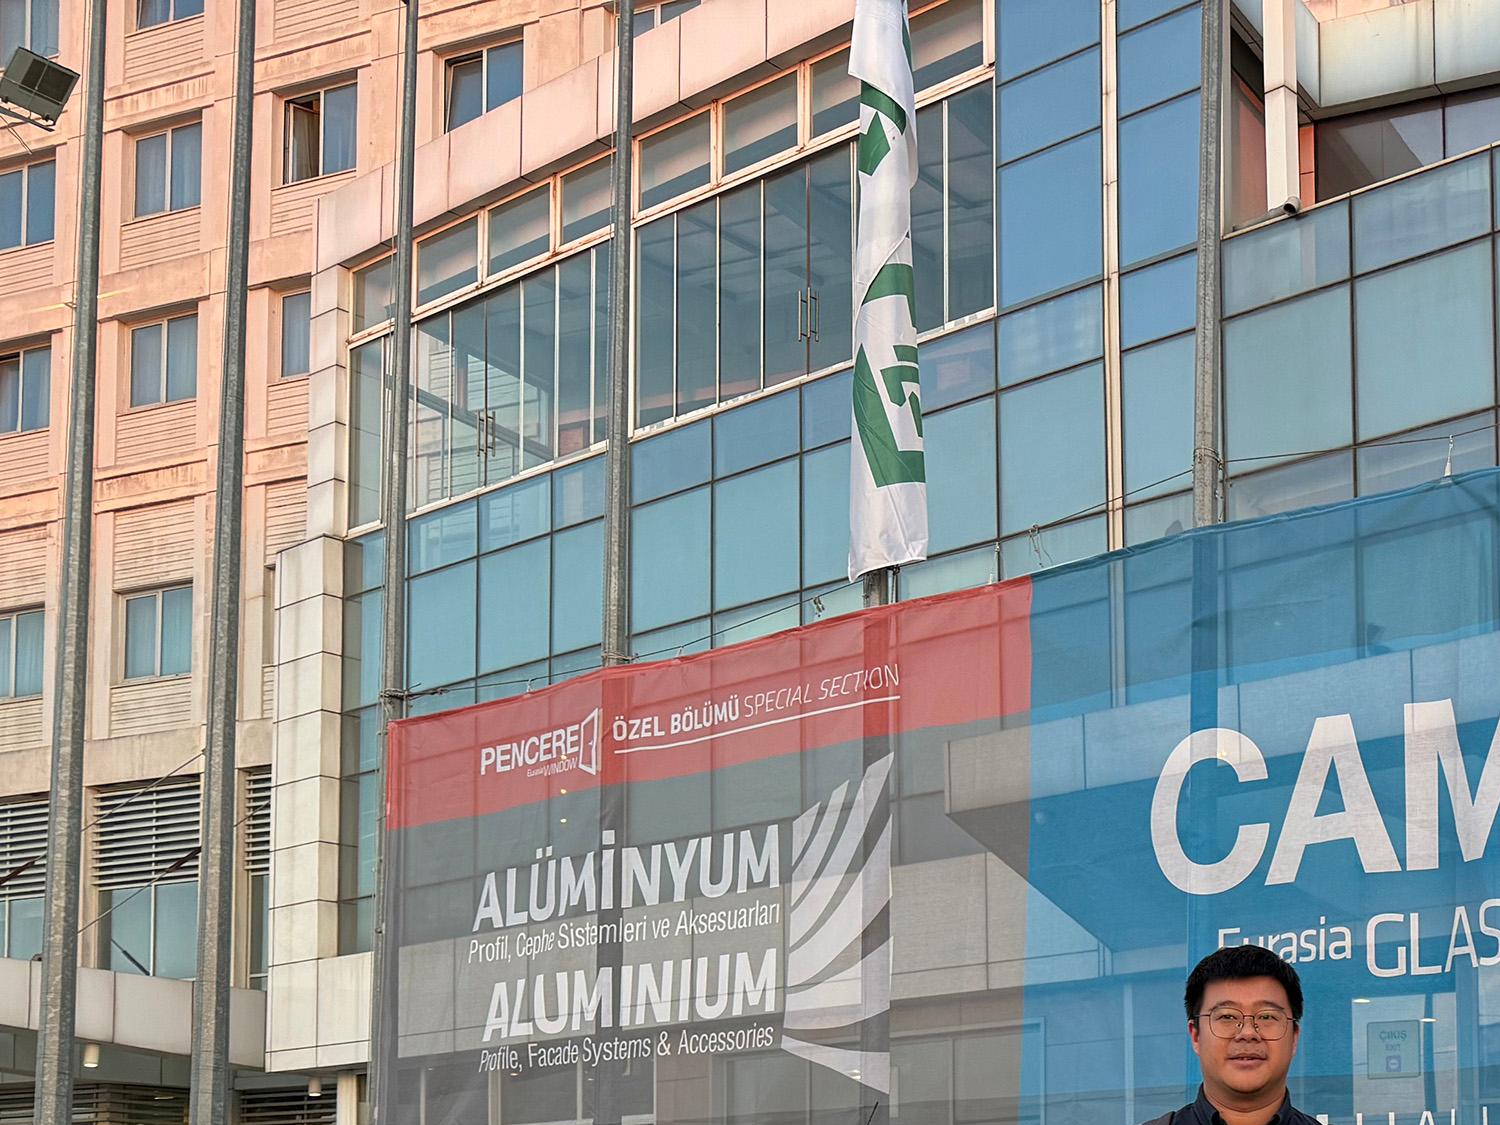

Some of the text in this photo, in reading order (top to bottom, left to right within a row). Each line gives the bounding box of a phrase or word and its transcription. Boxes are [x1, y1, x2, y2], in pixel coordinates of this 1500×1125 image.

[612, 663, 900, 741] ÖZEL BÖLÜMÜ SPECIAL SECTION
[480, 725, 579, 776] PENCERE
[472, 824, 780, 932] ALÜMİNYUM
[468, 900, 780, 964] Profil, Cephe Sistemleri ve Aksesuarları
[481, 948, 777, 1042] ALUMINIUM
[478, 1024, 774, 1072] Profile, Facade Systems & Accessories
